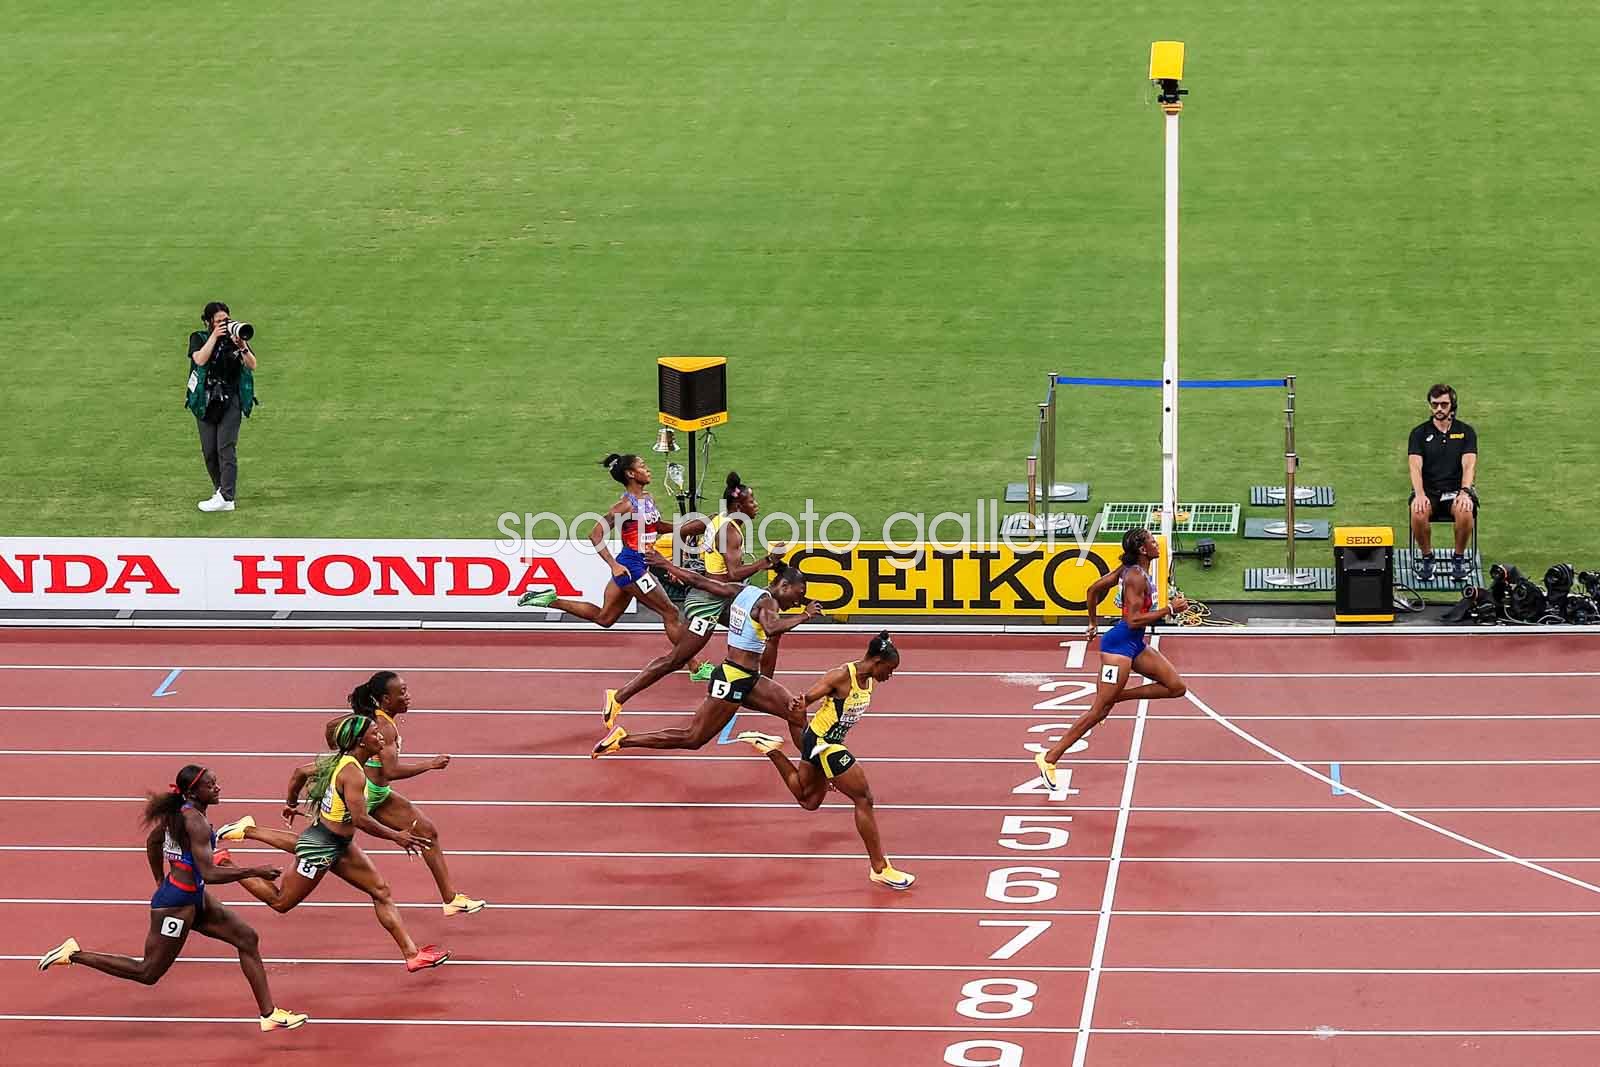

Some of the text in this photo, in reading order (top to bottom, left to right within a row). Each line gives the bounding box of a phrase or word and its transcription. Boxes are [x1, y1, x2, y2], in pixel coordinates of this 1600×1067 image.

[1346, 536, 1383, 545] SEIKO
[233, 555, 583, 597] HONDA
[642, 578, 653, 590] 2
[789, 549, 1111, 611] SEIKO
[694, 621, 703, 632] 3
[1059, 640, 1089, 669] 1
[1105, 669, 1113, 681] 4
[717, 684, 725, 696] 5
[1033, 681, 1097, 710] 2
[1024, 723, 1093, 754] 3
[1011, 768, 1080, 801] 4
[997, 815, 1073, 851] 5
[302, 861, 311, 873] 8
[985, 866, 1060, 904] 6
[167, 921, 178, 934] 9
[978, 920, 1053, 960] 7
[955, 977, 1039, 1020] 8
[943, 1039, 1024, 1067] 9
